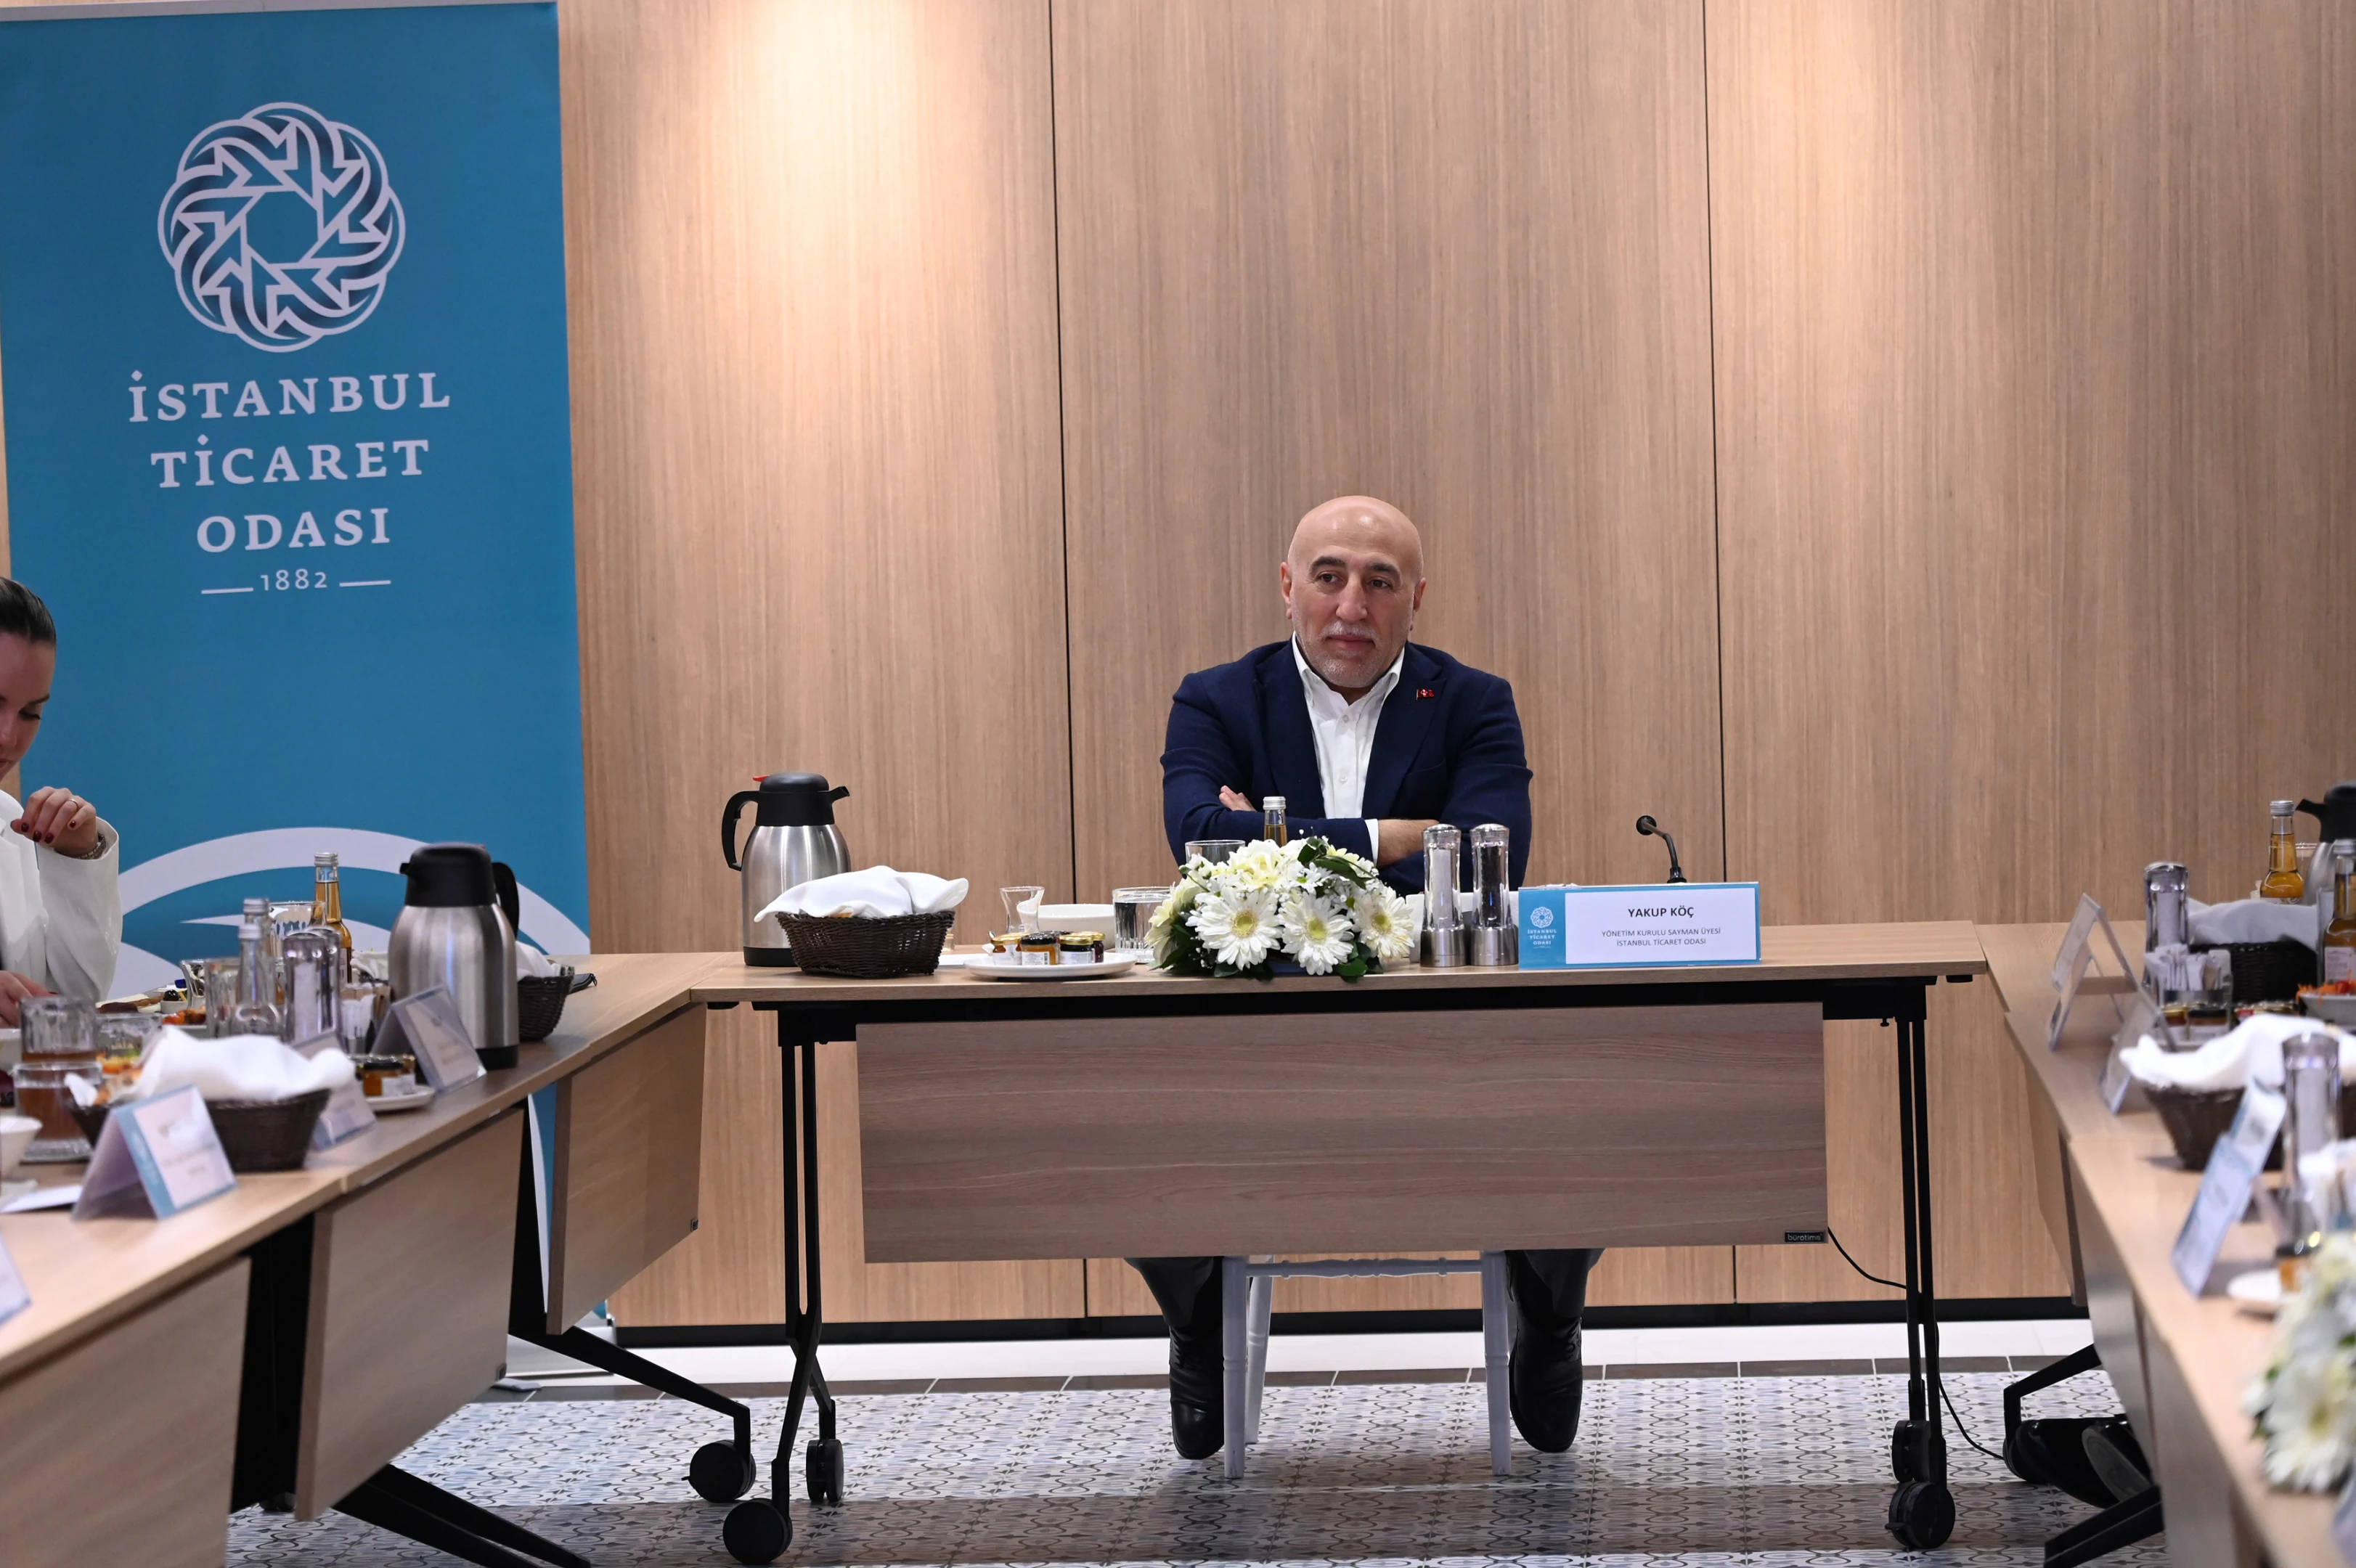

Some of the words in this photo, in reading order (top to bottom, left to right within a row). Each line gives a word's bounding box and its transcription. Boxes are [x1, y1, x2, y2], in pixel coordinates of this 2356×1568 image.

[129, 370, 449, 422] İSTANBUL
[151, 435, 428, 488] TİCARET
[197, 508, 390, 553] ODASI
[261, 568, 327, 591] 1882
[1628, 908, 1667, 918] YAKUP
[1671, 905, 1695, 918] KÖÇ
[1700, 926, 1721, 935] ÜYESİ
